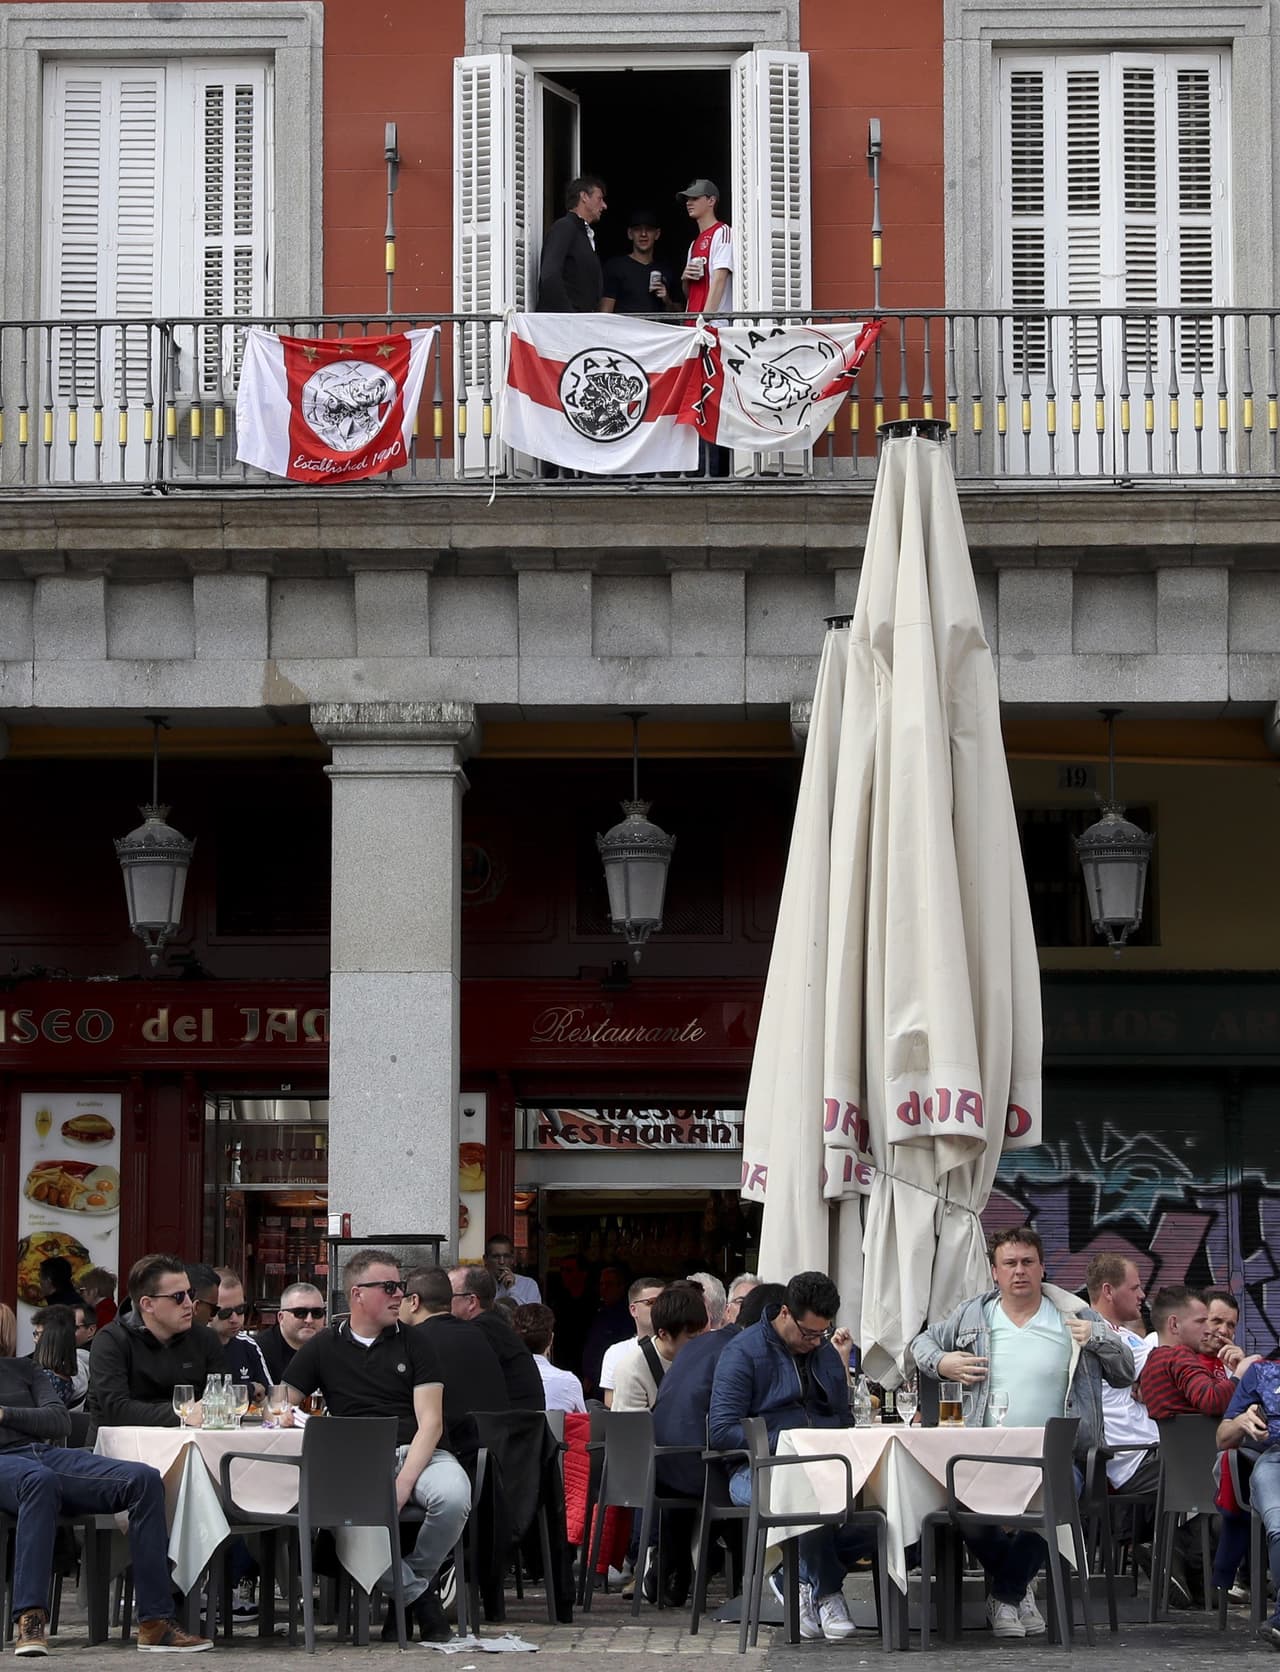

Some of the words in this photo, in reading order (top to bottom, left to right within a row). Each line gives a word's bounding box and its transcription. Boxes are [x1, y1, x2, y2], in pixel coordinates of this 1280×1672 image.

[565, 356, 632, 409] AJAX
[141, 1007, 213, 1043] del
[528, 1006, 706, 1043] Restaurante
